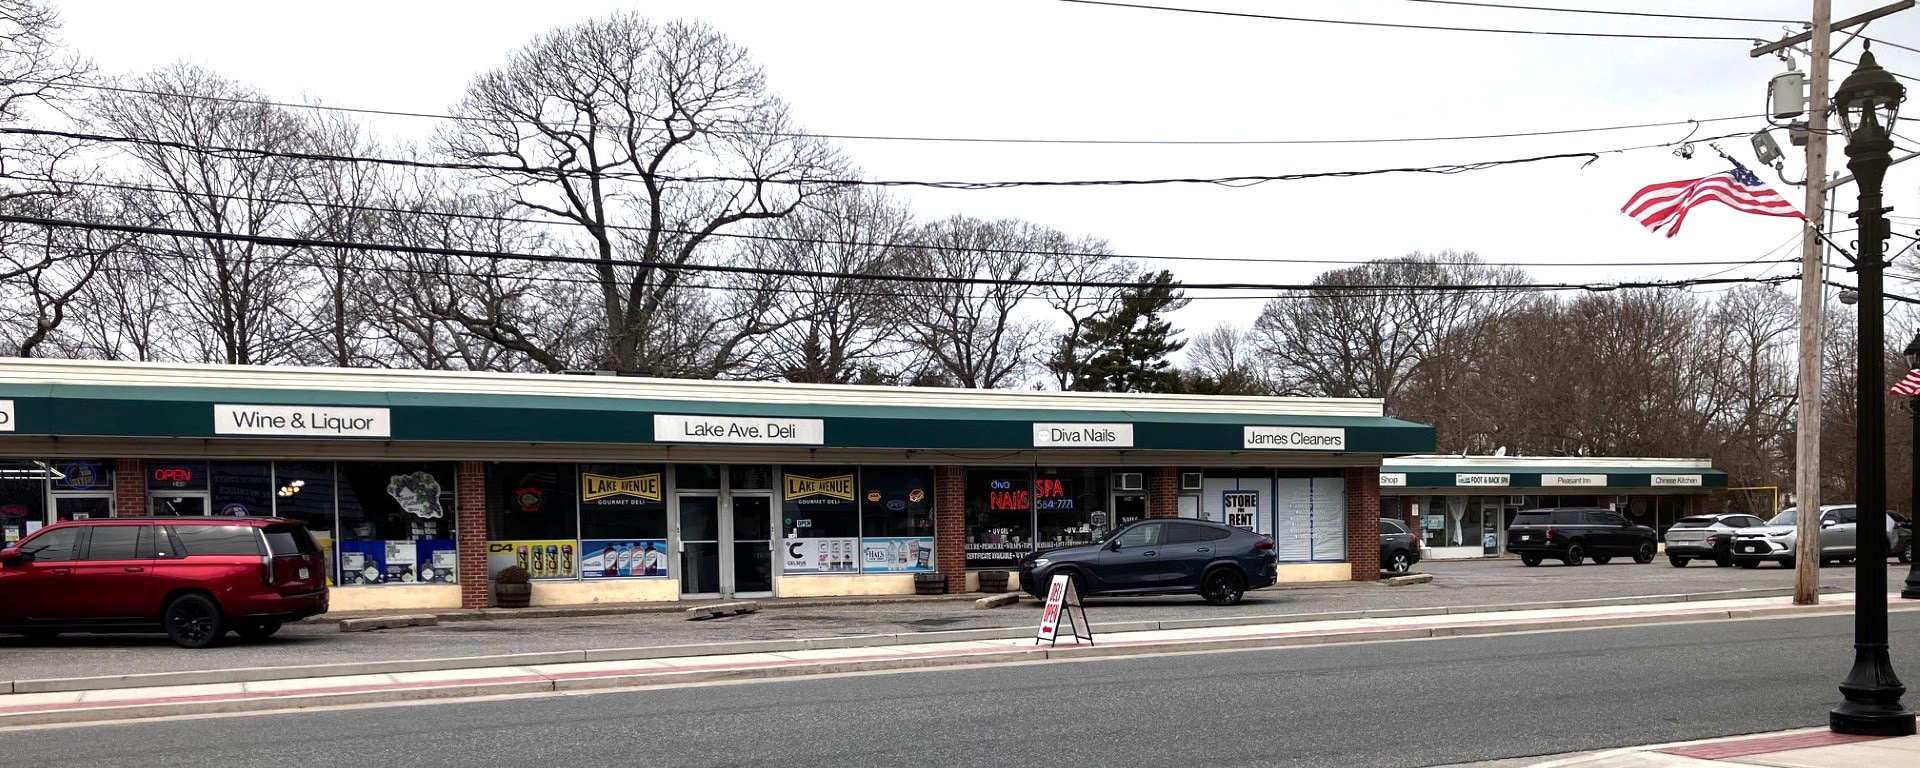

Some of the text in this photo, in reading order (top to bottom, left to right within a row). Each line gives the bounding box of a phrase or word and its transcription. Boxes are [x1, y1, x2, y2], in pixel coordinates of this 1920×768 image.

[232, 410, 374, 433] Wine & Liquor
[684, 421, 796, 439] Lake Ave. Deli
[1051, 428, 1081, 442] Diva
[1084, 428, 1116, 442] Nails
[1248, 431, 1342, 446] James Cleaners
[155, 468, 192, 482] OPEN
[1380, 476, 1399, 485] Shop
[1471, 476, 1483, 484] FOOT
[1488, 476, 1500, 484] BACK
[1557, 476, 1582, 485] Pleasant
[1655, 476, 1698, 485] Chinese Kitchen
[587, 478, 657, 494] LAKE AVENUE
[789, 479, 850, 495] LAKE AVENUE
[1036, 479, 1064, 498] SPA
[1225, 494, 1256, 507] STORE
[797, 519, 811, 527] OPEN
[1228, 513, 1254, 526] RENT
[489, 543, 514, 553] C4
[1050, 582, 1063, 602] DELI
[1043, 603, 1060, 623] OPEN
